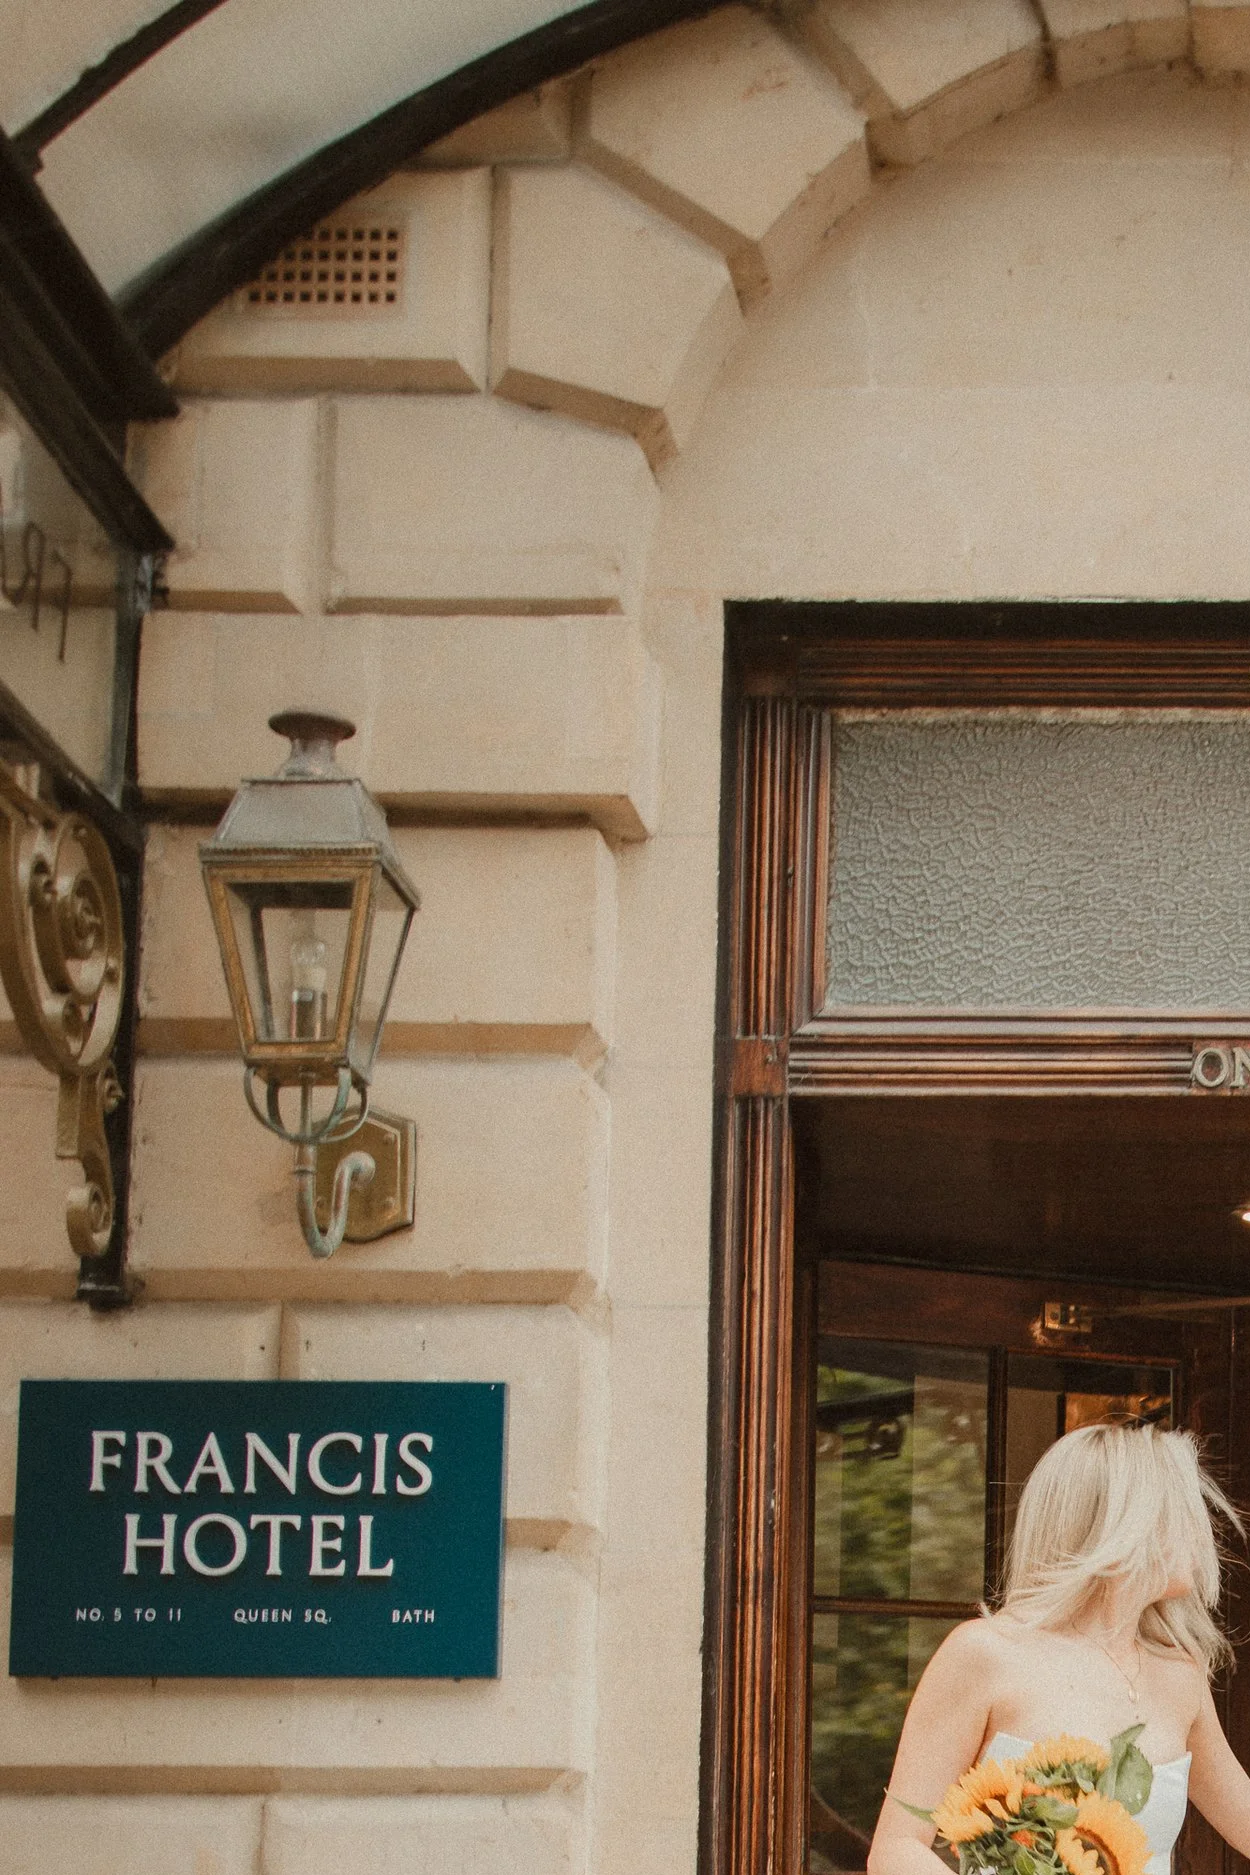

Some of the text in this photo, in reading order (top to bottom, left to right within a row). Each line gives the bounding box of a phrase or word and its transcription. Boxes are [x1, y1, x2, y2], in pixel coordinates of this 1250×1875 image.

[88, 1430, 434, 1496] FRANCIS
[122, 1512, 395, 1577] HOTEL
[113, 1607, 122, 1622] 5
[134, 1607, 157, 1622] TO
[233, 1608, 293, 1624] QUEEN
[391, 1608, 436, 1624] BATH
